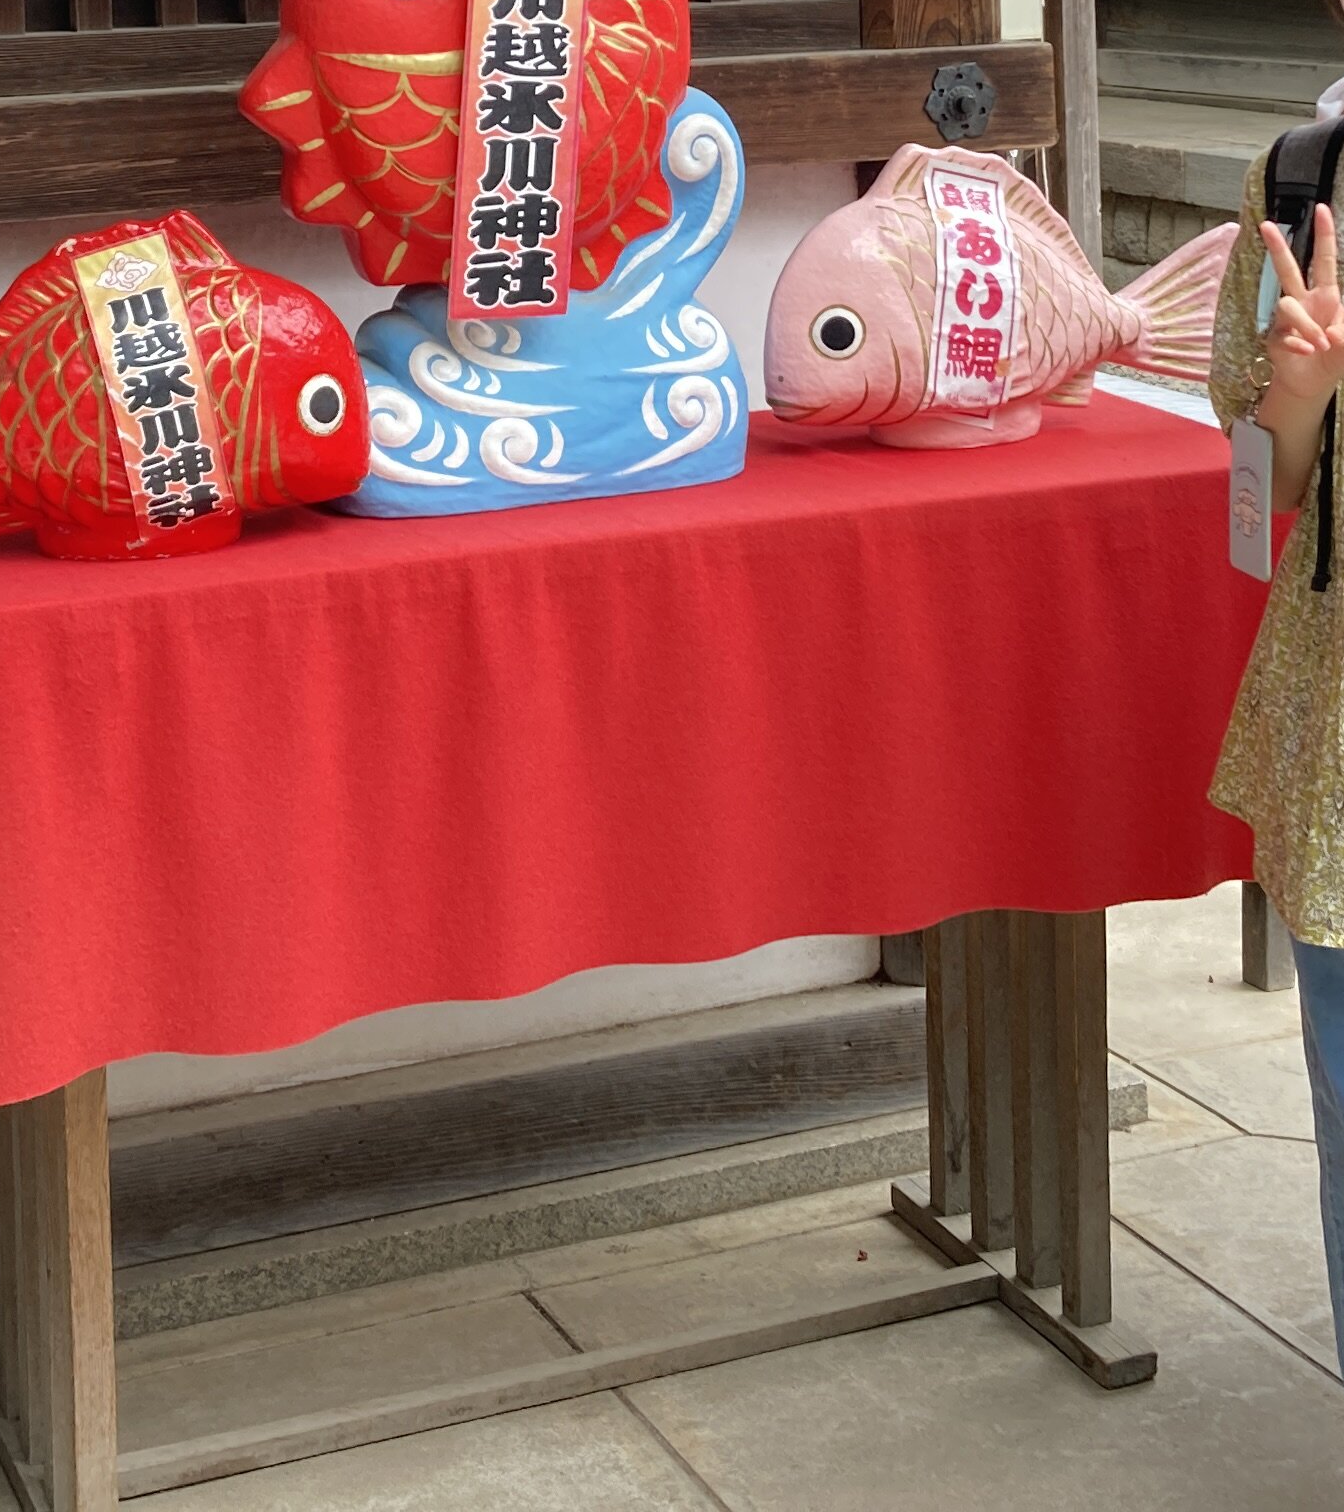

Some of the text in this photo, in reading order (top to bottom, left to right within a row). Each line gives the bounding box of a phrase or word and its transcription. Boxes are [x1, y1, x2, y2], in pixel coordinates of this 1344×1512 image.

[939, 182, 992, 215] 良縁
[943, 217, 1004, 383] あい鯛
[106, 286, 220, 528] 川越氷川神社
